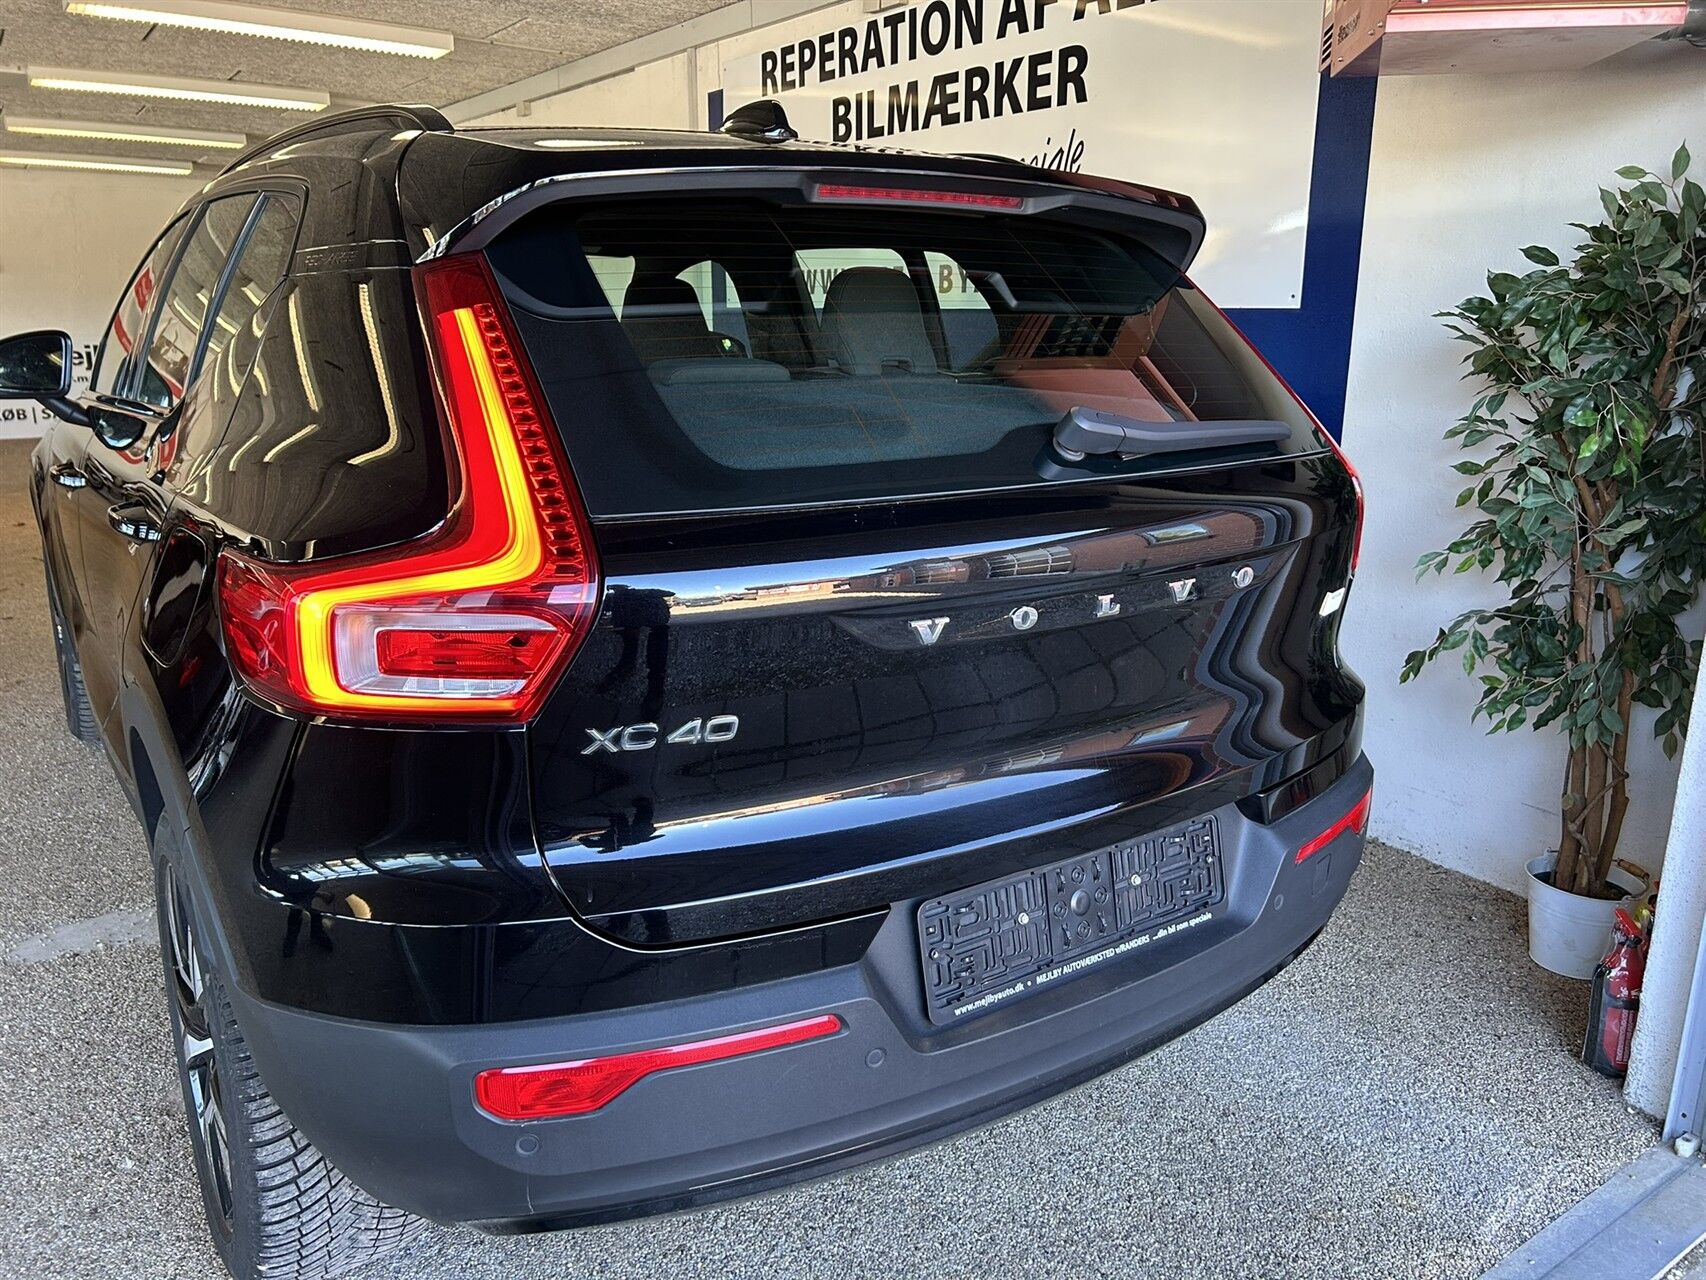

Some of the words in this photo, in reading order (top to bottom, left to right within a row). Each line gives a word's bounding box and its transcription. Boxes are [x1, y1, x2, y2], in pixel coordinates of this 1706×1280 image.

[760, 0, 984, 97] REPERATION
[831, 44, 1090, 143] BILMÆRKER
[908, 566, 1255, 646] VOLVO
